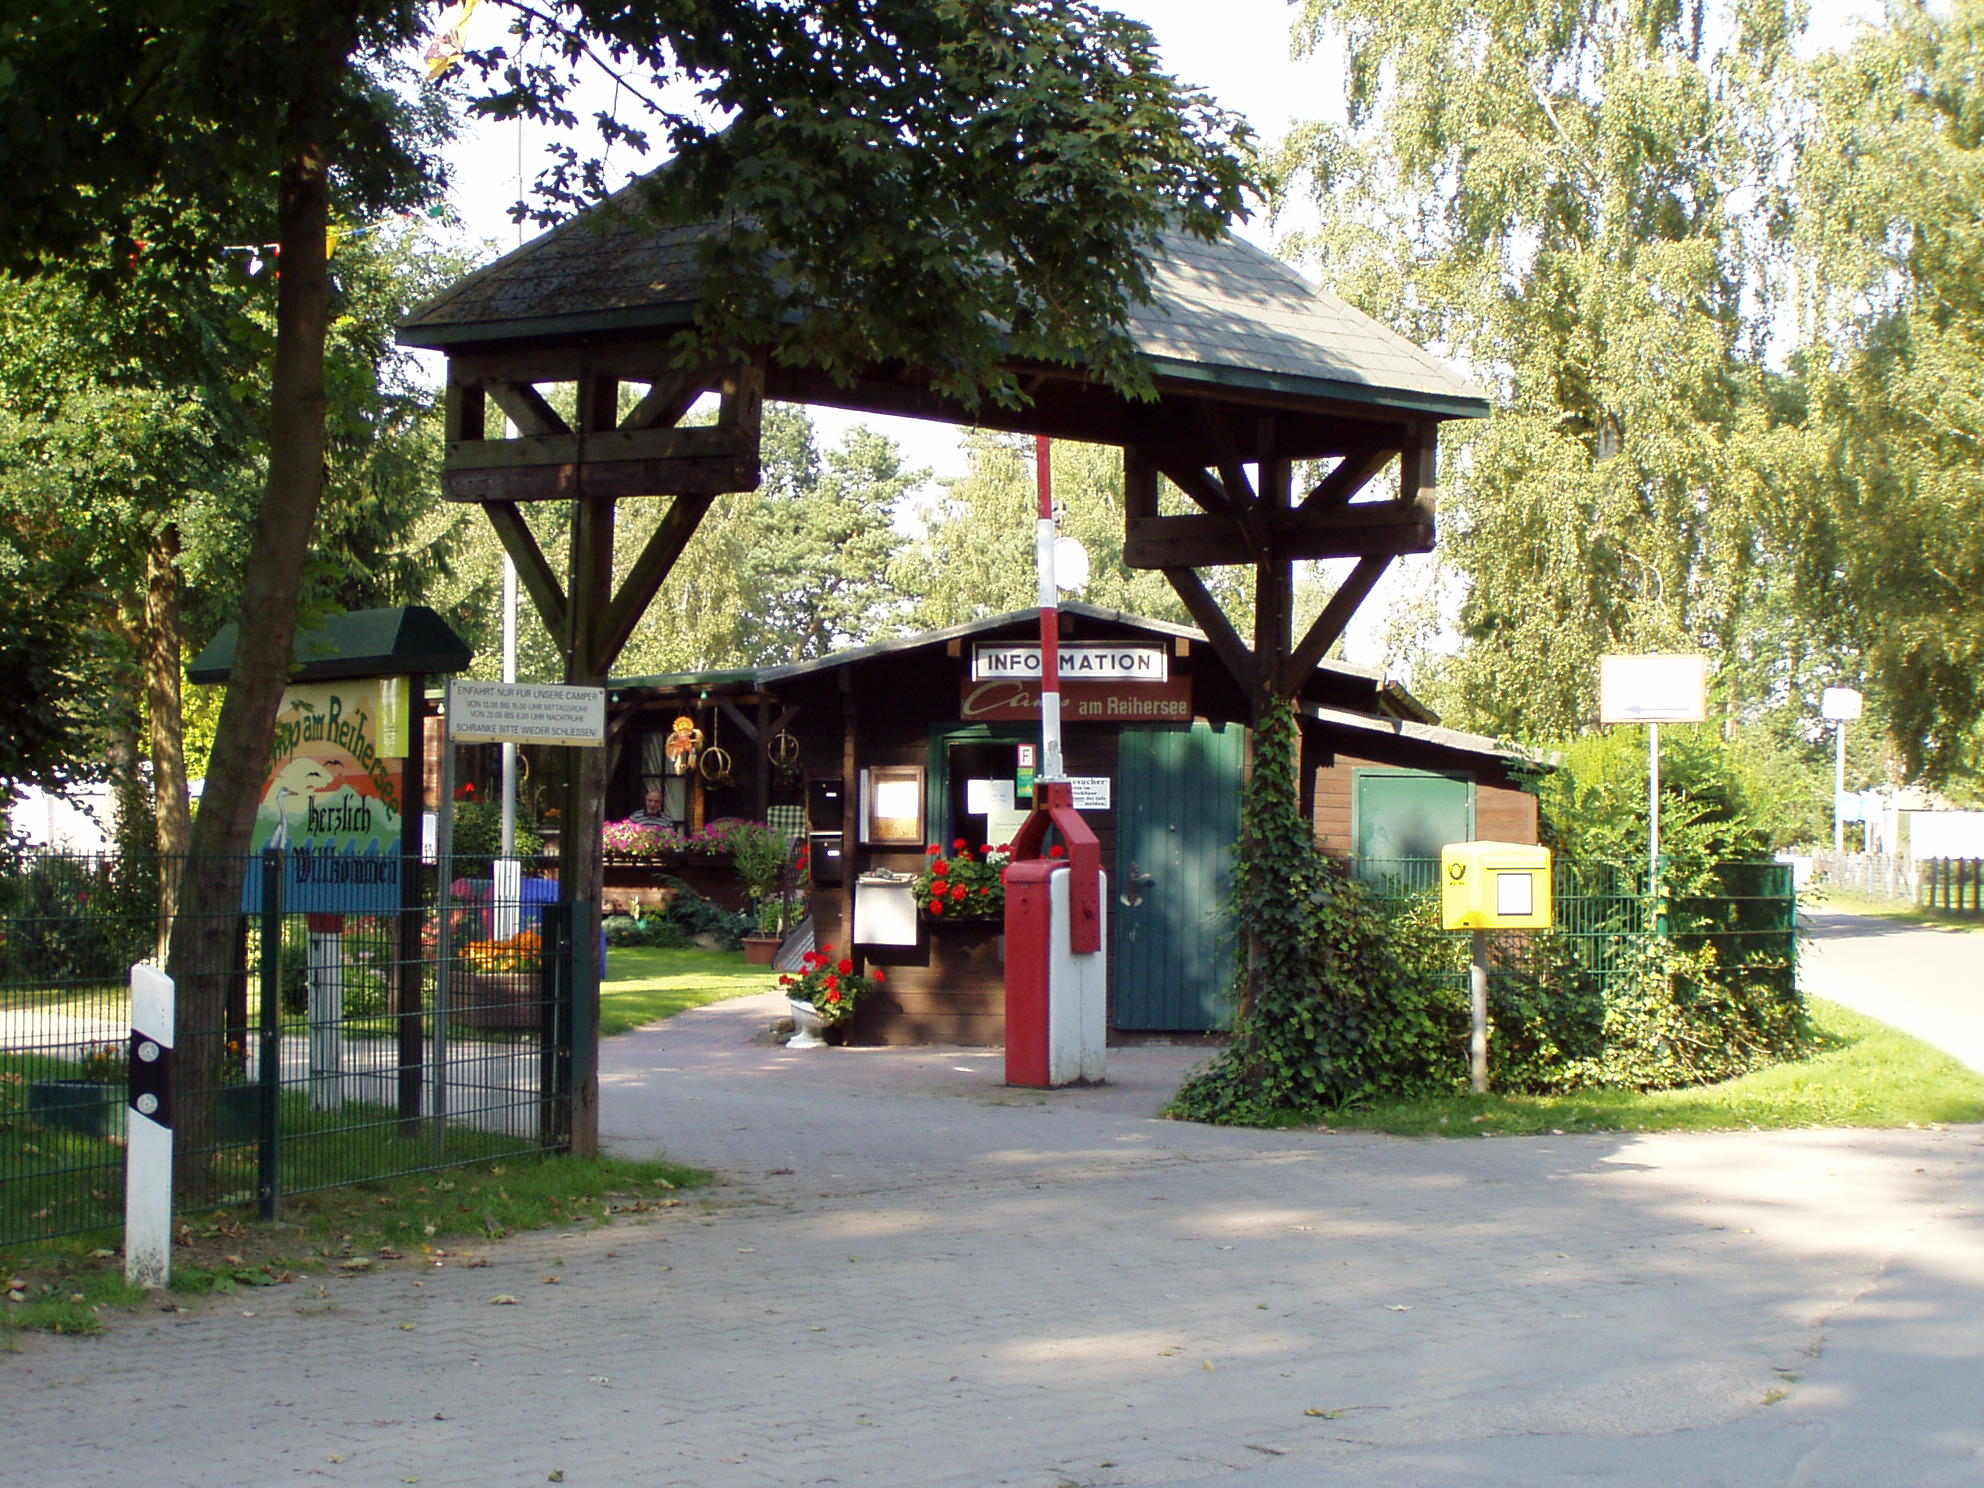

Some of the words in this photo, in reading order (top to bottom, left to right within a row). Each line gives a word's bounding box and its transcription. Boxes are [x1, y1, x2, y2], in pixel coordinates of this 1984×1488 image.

[988, 654, 1150, 670] INFOMATION
[457, 686, 495, 697] EINFAHRT
[497, 688, 514, 698] NUR
[533, 690, 564, 700] UNSERE
[565, 691, 598, 702] CAMPER
[467, 700, 481, 708] VON
[500, 702, 510, 710] BIS
[528, 703, 543, 711] UHR
[1079, 701, 1102, 715] am
[1107, 696, 1188, 715] Reihersee
[470, 710, 485, 718] VON
[504, 712, 515, 720] BIS
[530, 713, 545, 721] UHR
[456, 723, 497, 733] SCHRANKE
[499, 725, 519, 734] BITTE
[520, 726, 550, 735] WIEDER
[303, 713, 326, 742] am
[326, 695, 398, 821] Reihersee
[291, 846, 397, 884] Willkommen
